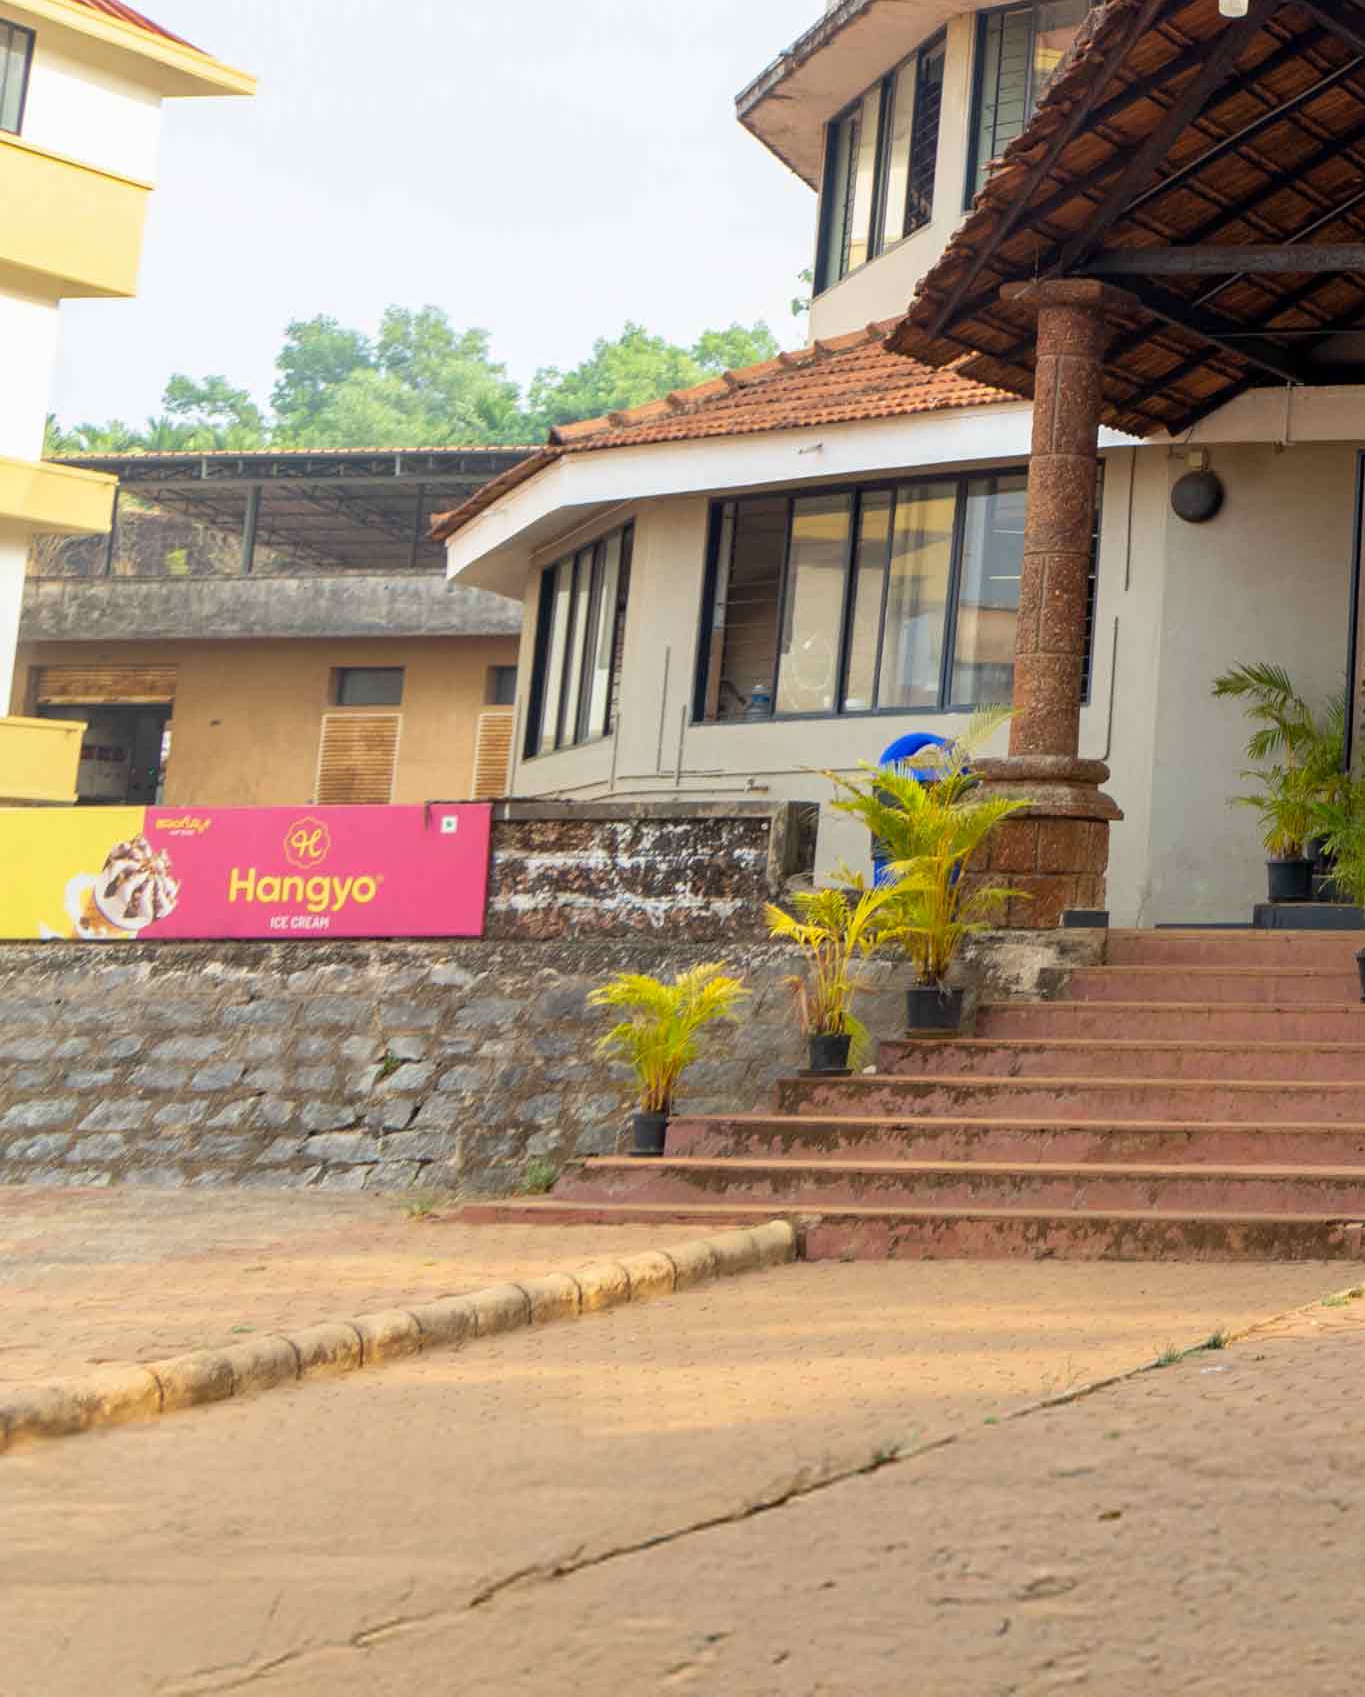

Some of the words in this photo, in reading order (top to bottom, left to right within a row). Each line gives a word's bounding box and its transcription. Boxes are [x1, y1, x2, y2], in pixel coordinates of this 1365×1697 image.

[228, 867, 377, 912] Hangyo
[269, 915, 289, 929] ICE
[290, 915, 330, 929] CREAM
